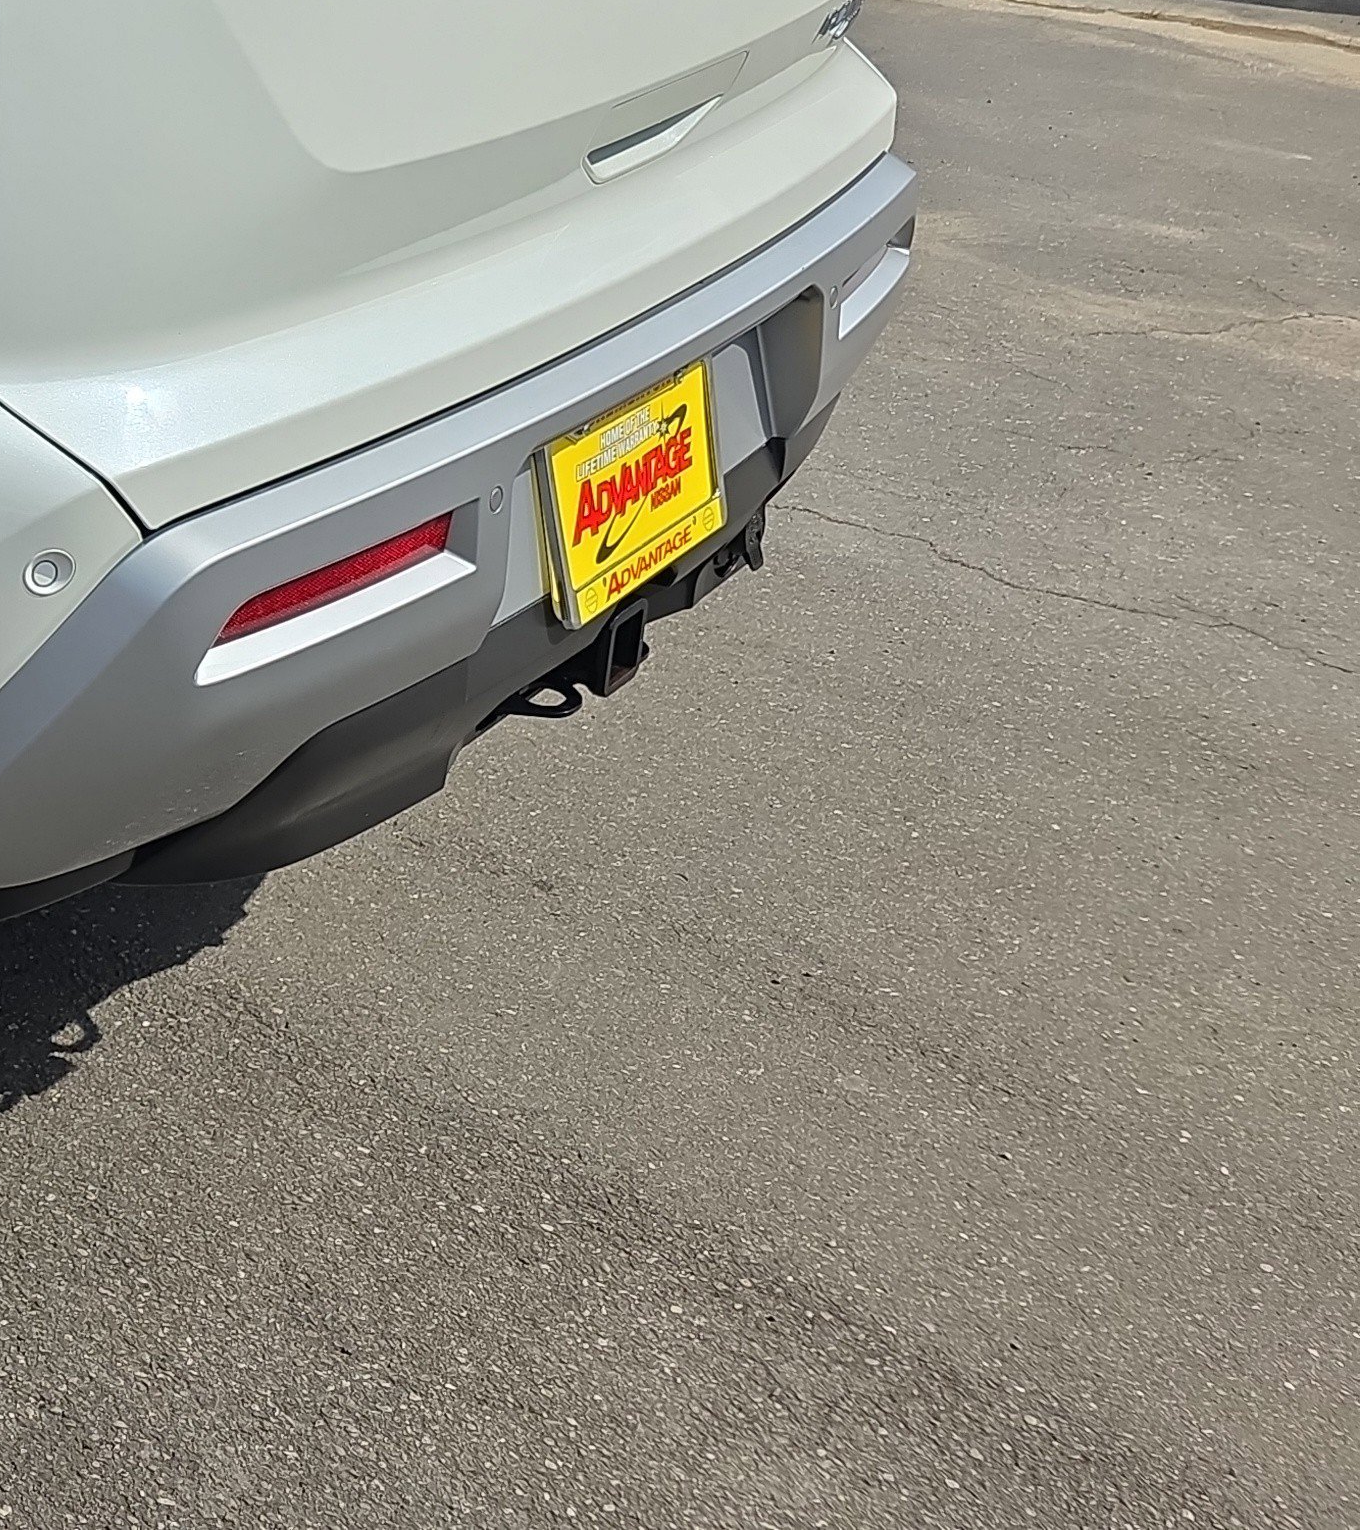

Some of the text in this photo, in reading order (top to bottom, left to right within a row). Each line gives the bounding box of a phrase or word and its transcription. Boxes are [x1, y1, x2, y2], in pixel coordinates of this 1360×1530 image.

[576, 419, 658, 482] LIFETIME WARRANTY
[600, 405, 651, 451] HOME OF THE
[572, 427, 692, 548] ADVANTAGE
